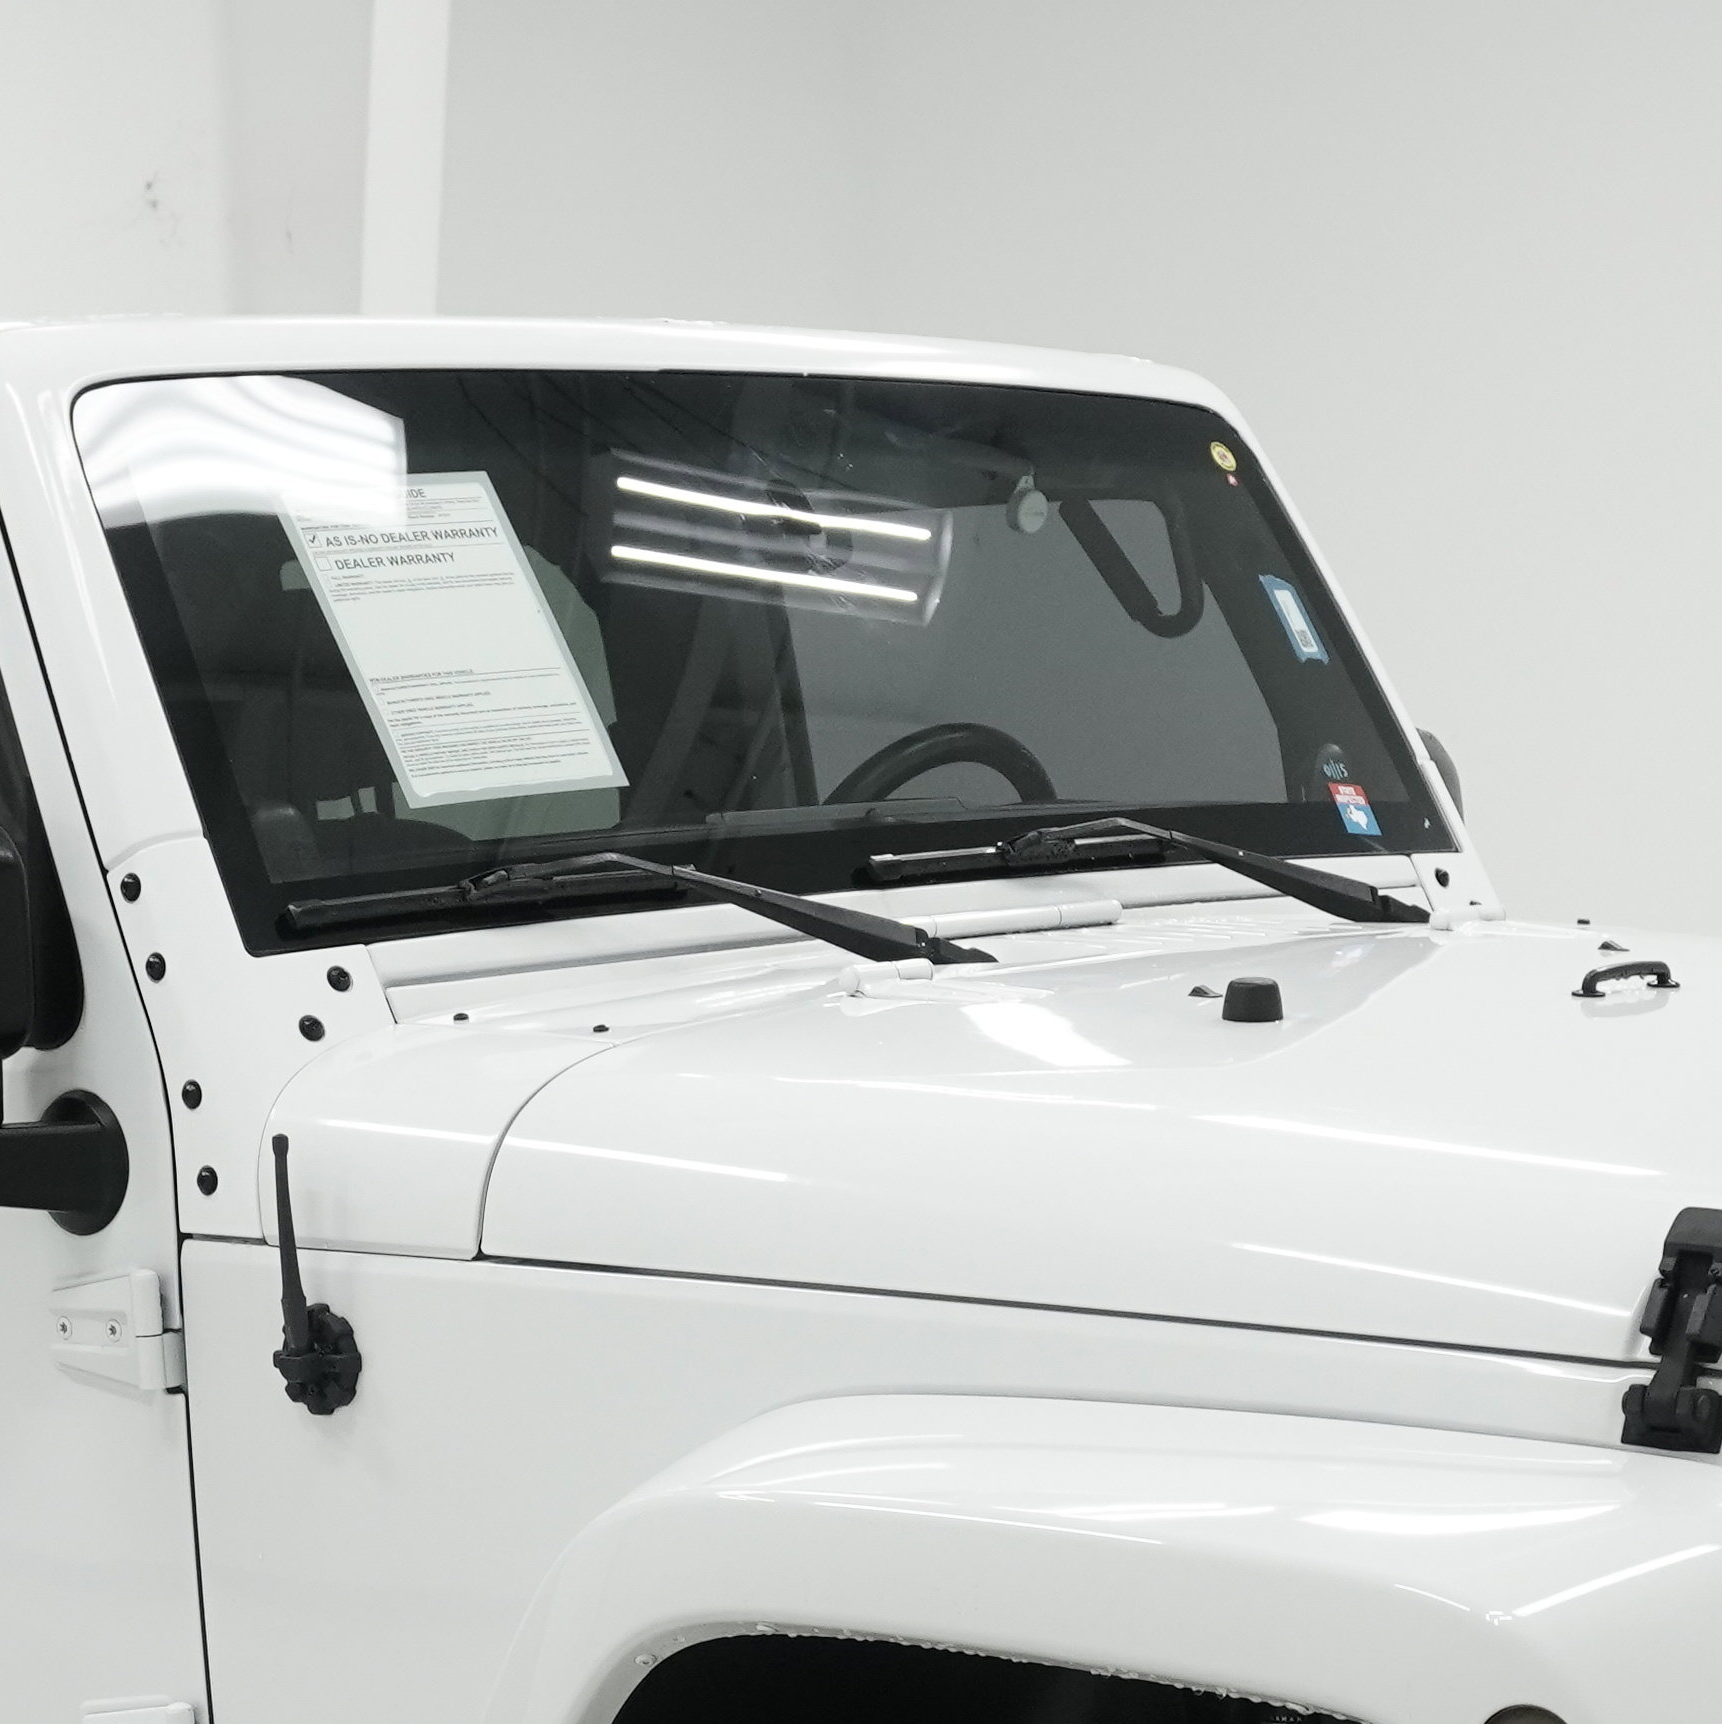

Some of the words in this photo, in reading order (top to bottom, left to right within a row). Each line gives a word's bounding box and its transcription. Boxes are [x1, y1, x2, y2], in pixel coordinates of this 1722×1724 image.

[326, 536, 342, 548] AS
[345, 533, 378, 546] IS-NO
[380, 530, 430, 544] DEALER
[432, 526, 498, 540] WARRANTY
[334, 555, 385, 570] DEALER
[386, 552, 455, 567] WARRANTY
